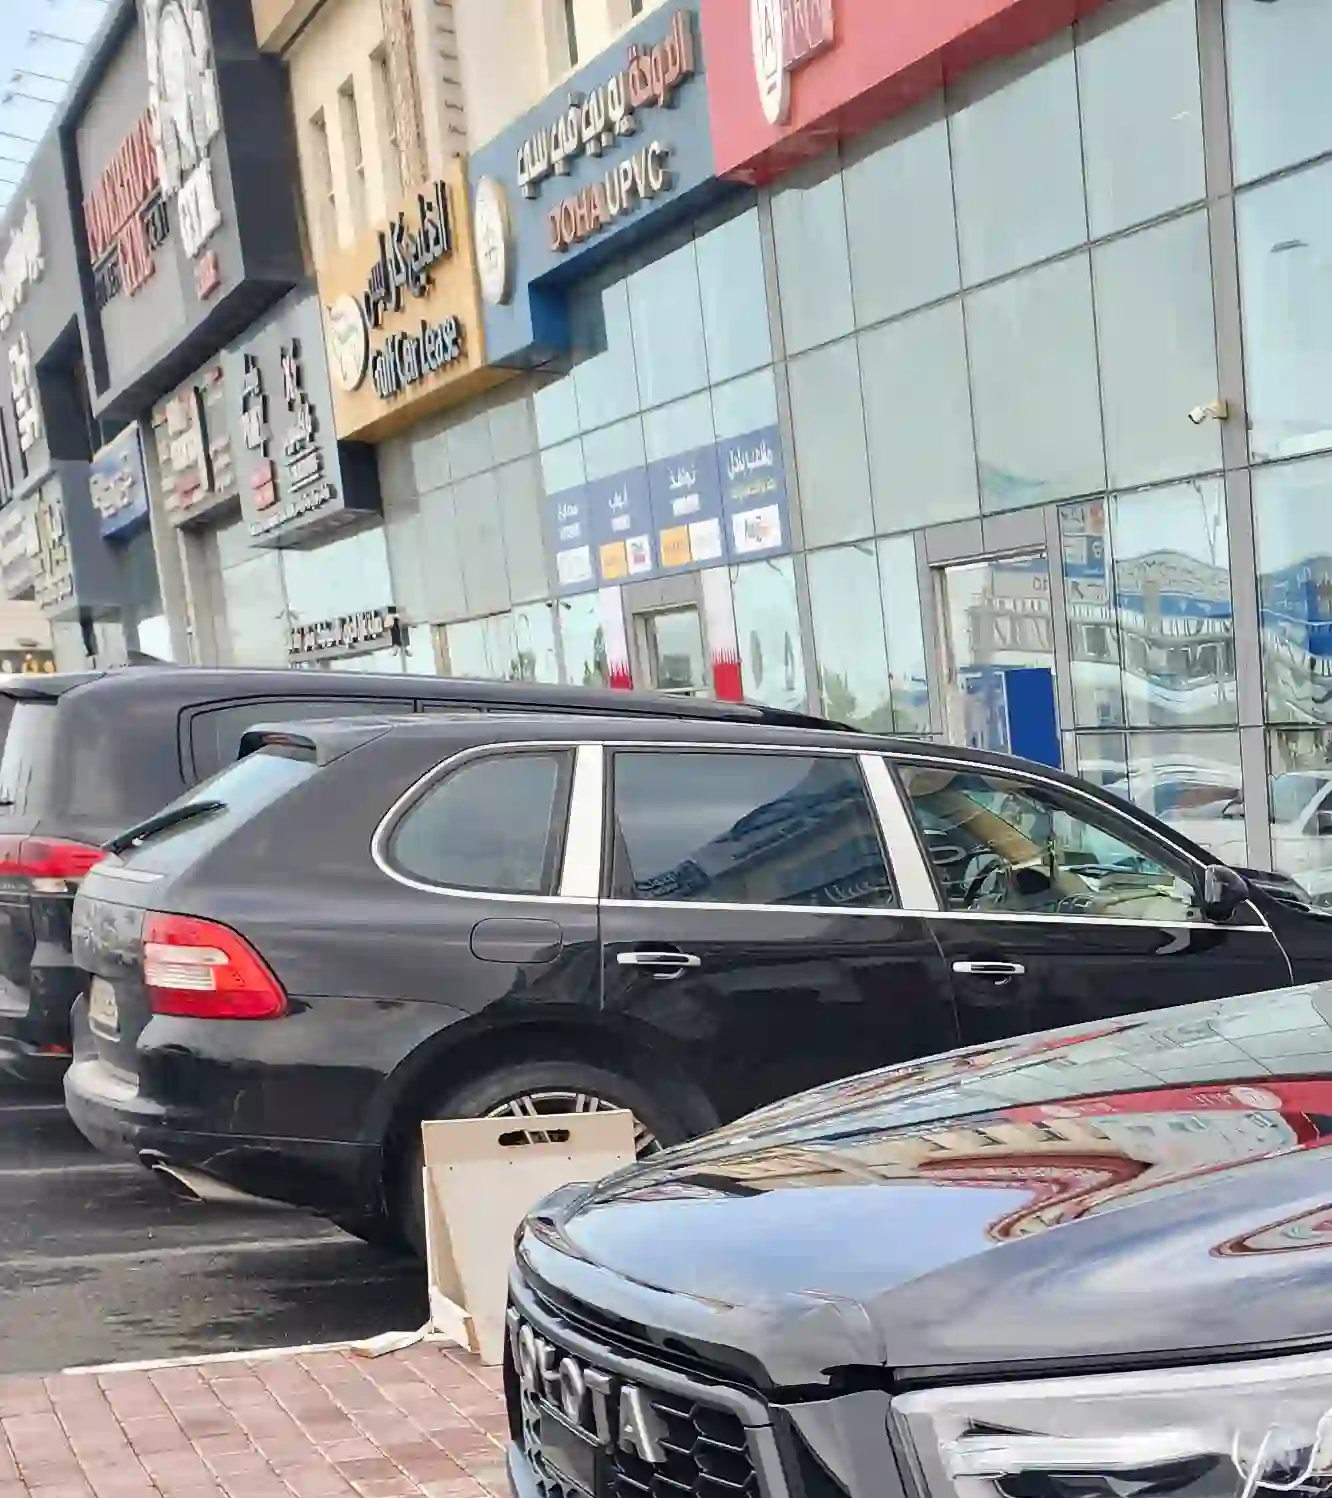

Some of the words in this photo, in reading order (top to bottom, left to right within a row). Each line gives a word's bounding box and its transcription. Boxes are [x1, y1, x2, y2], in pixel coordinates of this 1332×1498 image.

[604, 140, 668, 214] UPVC
[394, 331, 420, 384] Car
[420, 315, 461, 374] Lease
[506, 1305, 669, 1463] TOYOTA
